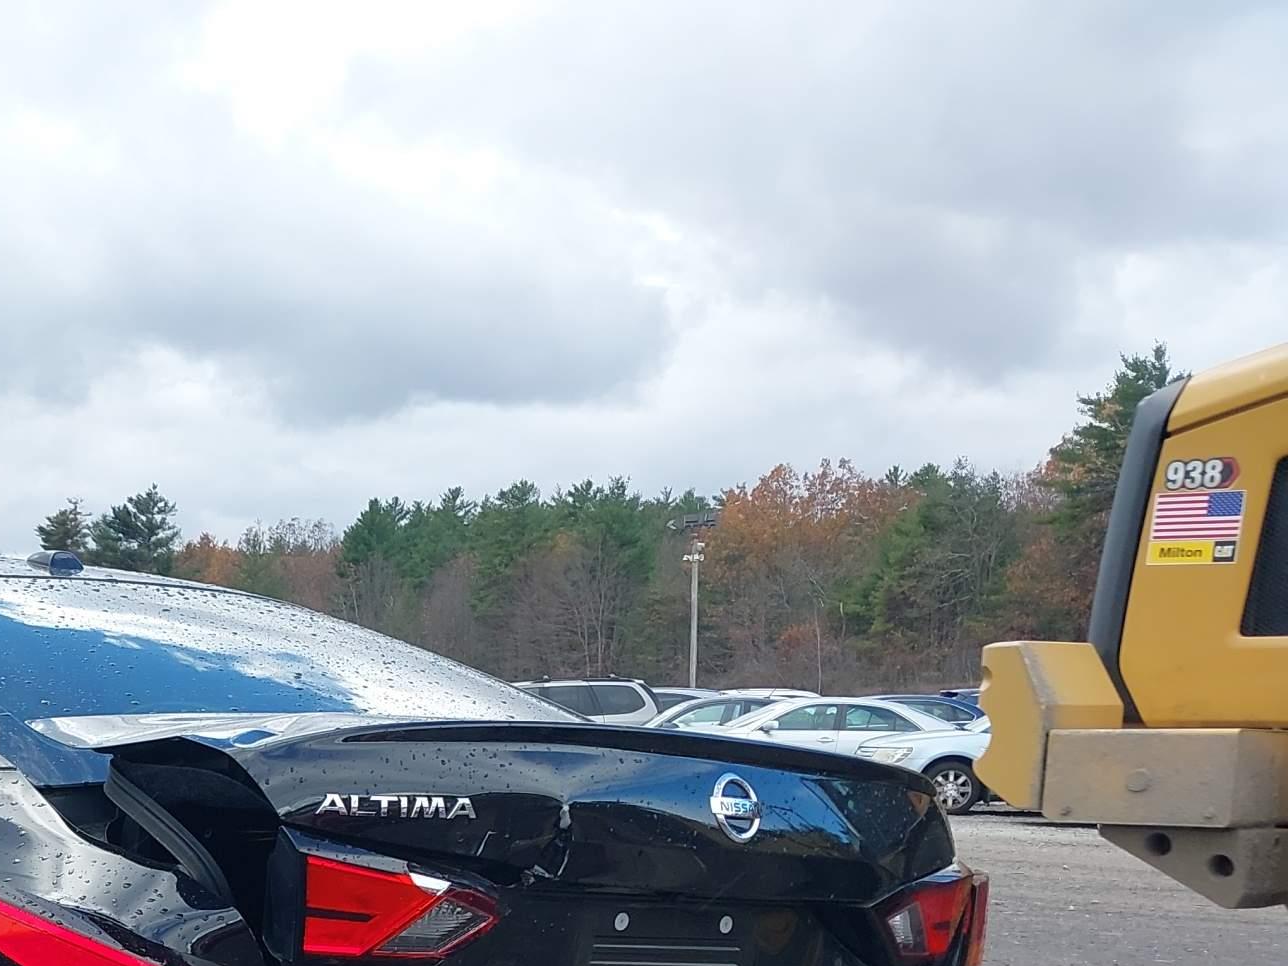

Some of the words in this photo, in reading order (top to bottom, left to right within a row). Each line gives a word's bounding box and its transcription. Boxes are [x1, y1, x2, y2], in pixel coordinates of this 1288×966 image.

[1166, 459, 1224, 490] 938
[1158, 546, 1203, 558] Milton
[314, 793, 477, 820] ALTIMA
